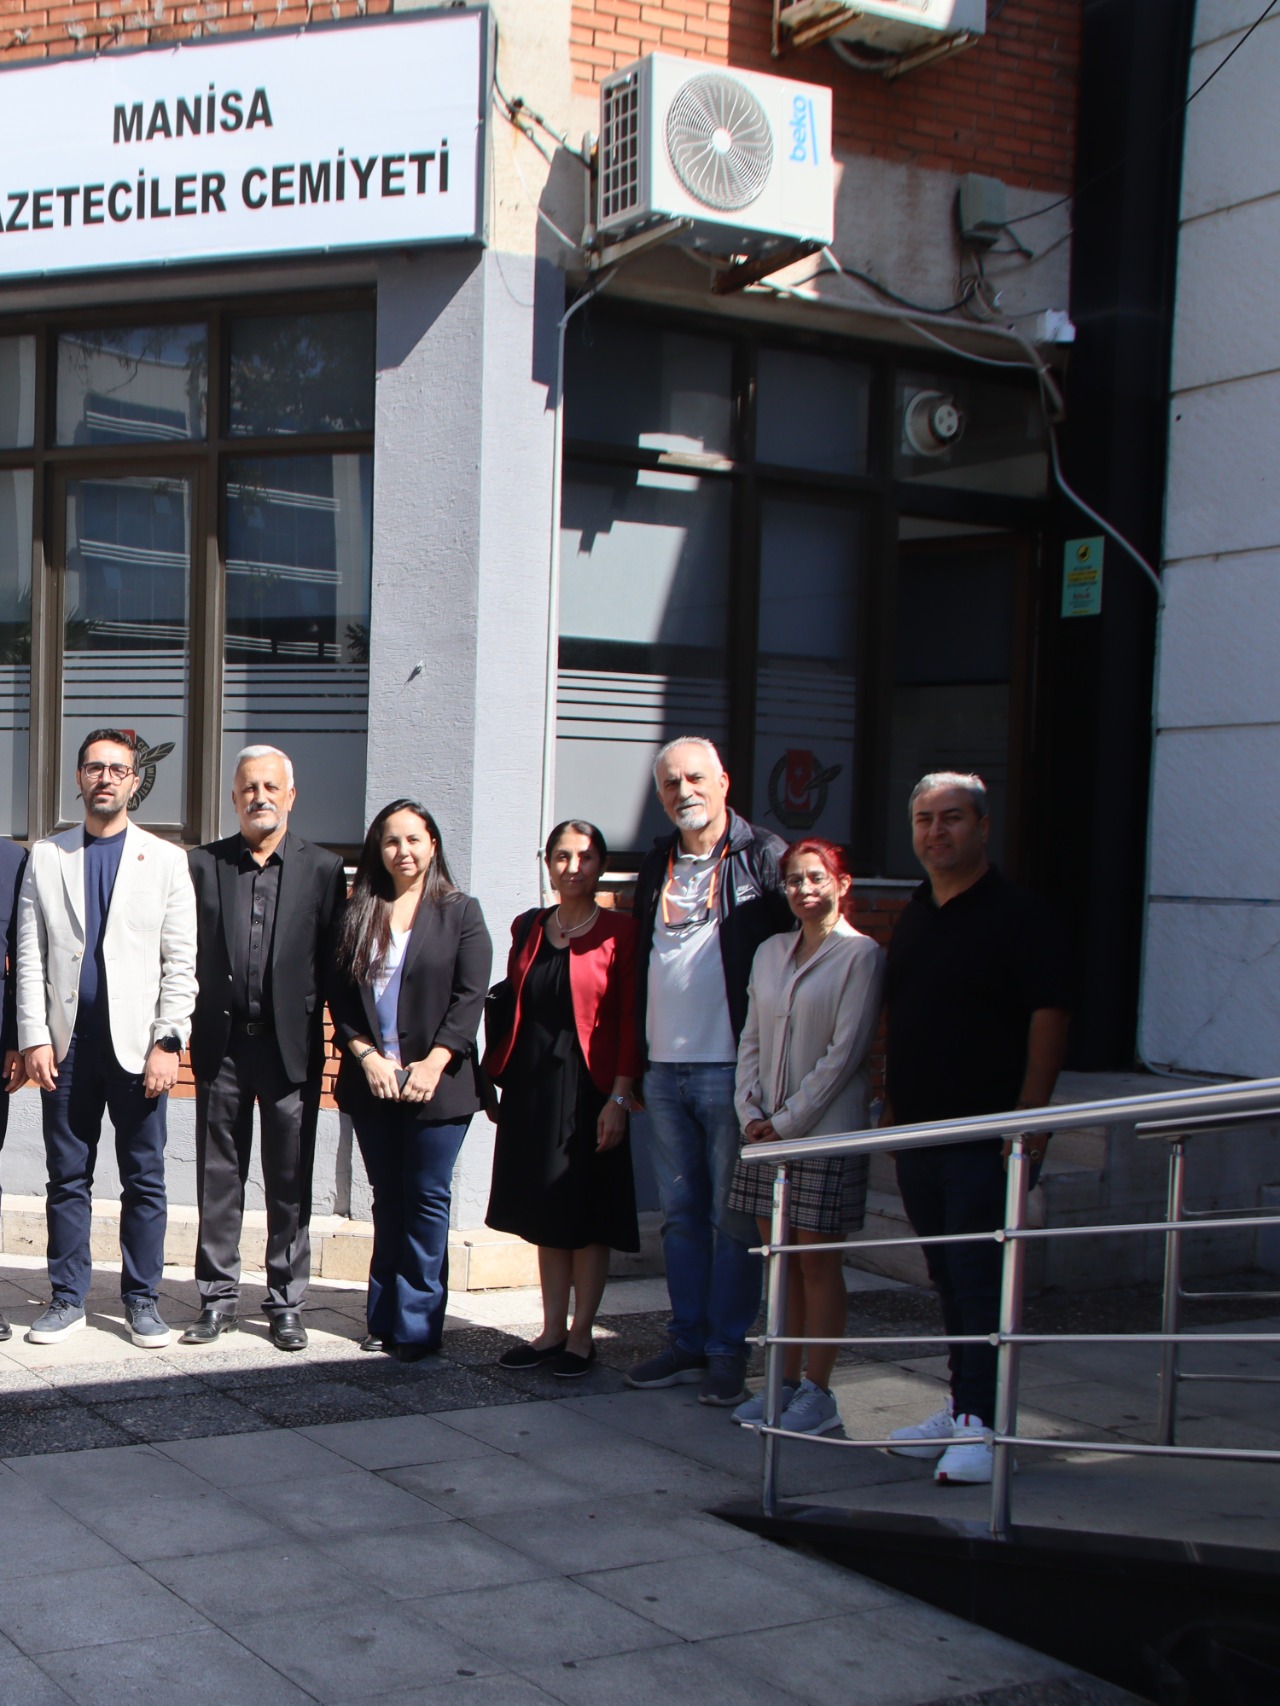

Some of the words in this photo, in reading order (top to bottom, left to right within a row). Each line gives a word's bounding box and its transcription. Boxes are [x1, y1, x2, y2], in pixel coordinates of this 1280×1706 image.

[113, 83, 273, 145] MANİSA
[789, 94, 807, 162] beko
[242, 138, 450, 210] CEMİYETİ
